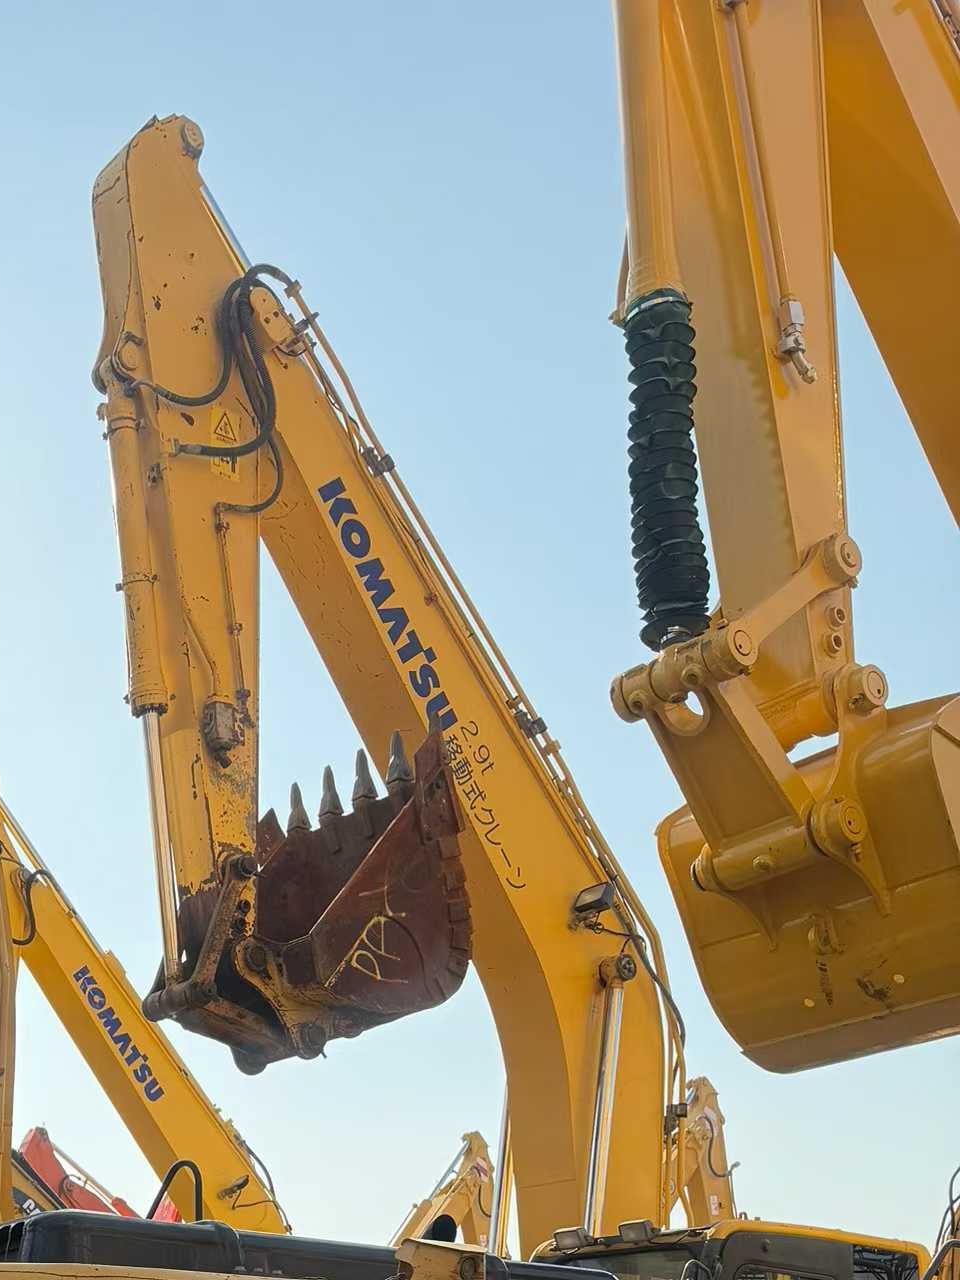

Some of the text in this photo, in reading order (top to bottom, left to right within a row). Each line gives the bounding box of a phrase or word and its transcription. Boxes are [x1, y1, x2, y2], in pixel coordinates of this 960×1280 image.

[318, 476, 458, 732] KOMATSU
[460, 720, 495, 776] 2.9t
[73, 965, 165, 1102] KOMATSU
